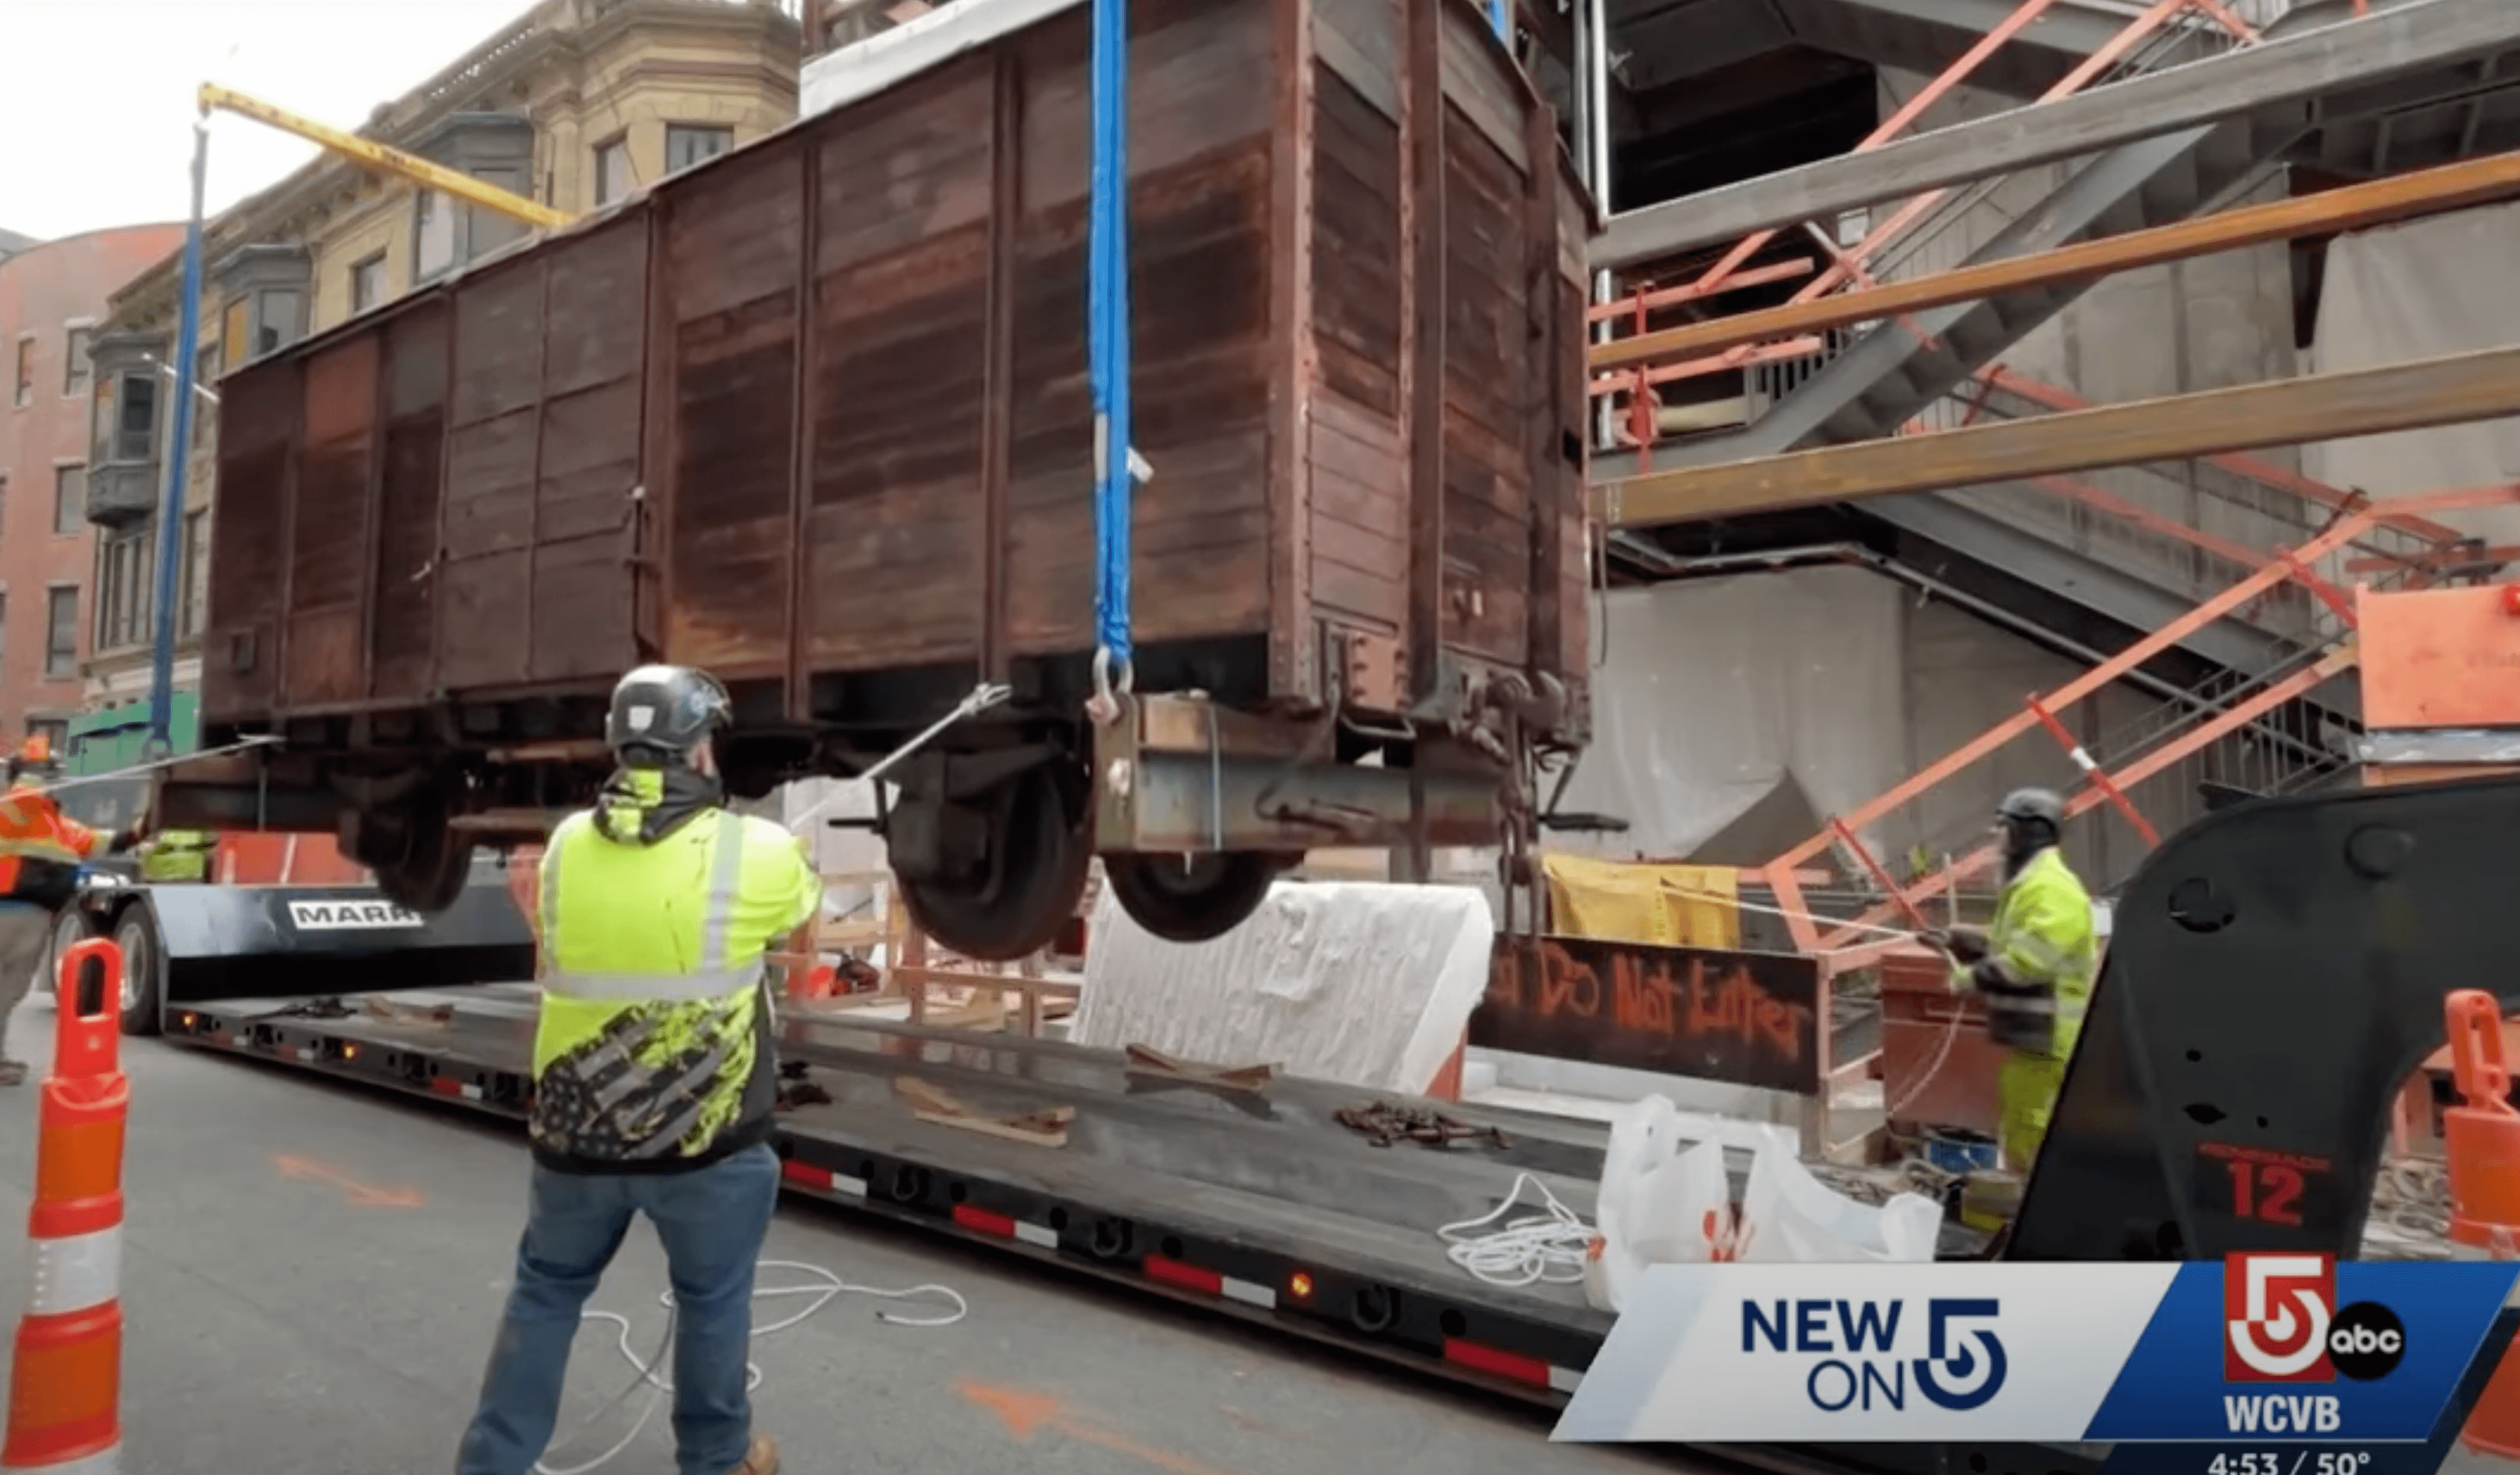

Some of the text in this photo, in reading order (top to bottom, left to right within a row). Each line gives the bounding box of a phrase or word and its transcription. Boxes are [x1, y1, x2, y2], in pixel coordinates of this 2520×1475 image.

[1538, 941, 1599, 1017] Do
[1612, 953, 1681, 1035] Not
[1689, 958, 1813, 1061] Enter
[2229, 1161, 2303, 1226] 12
